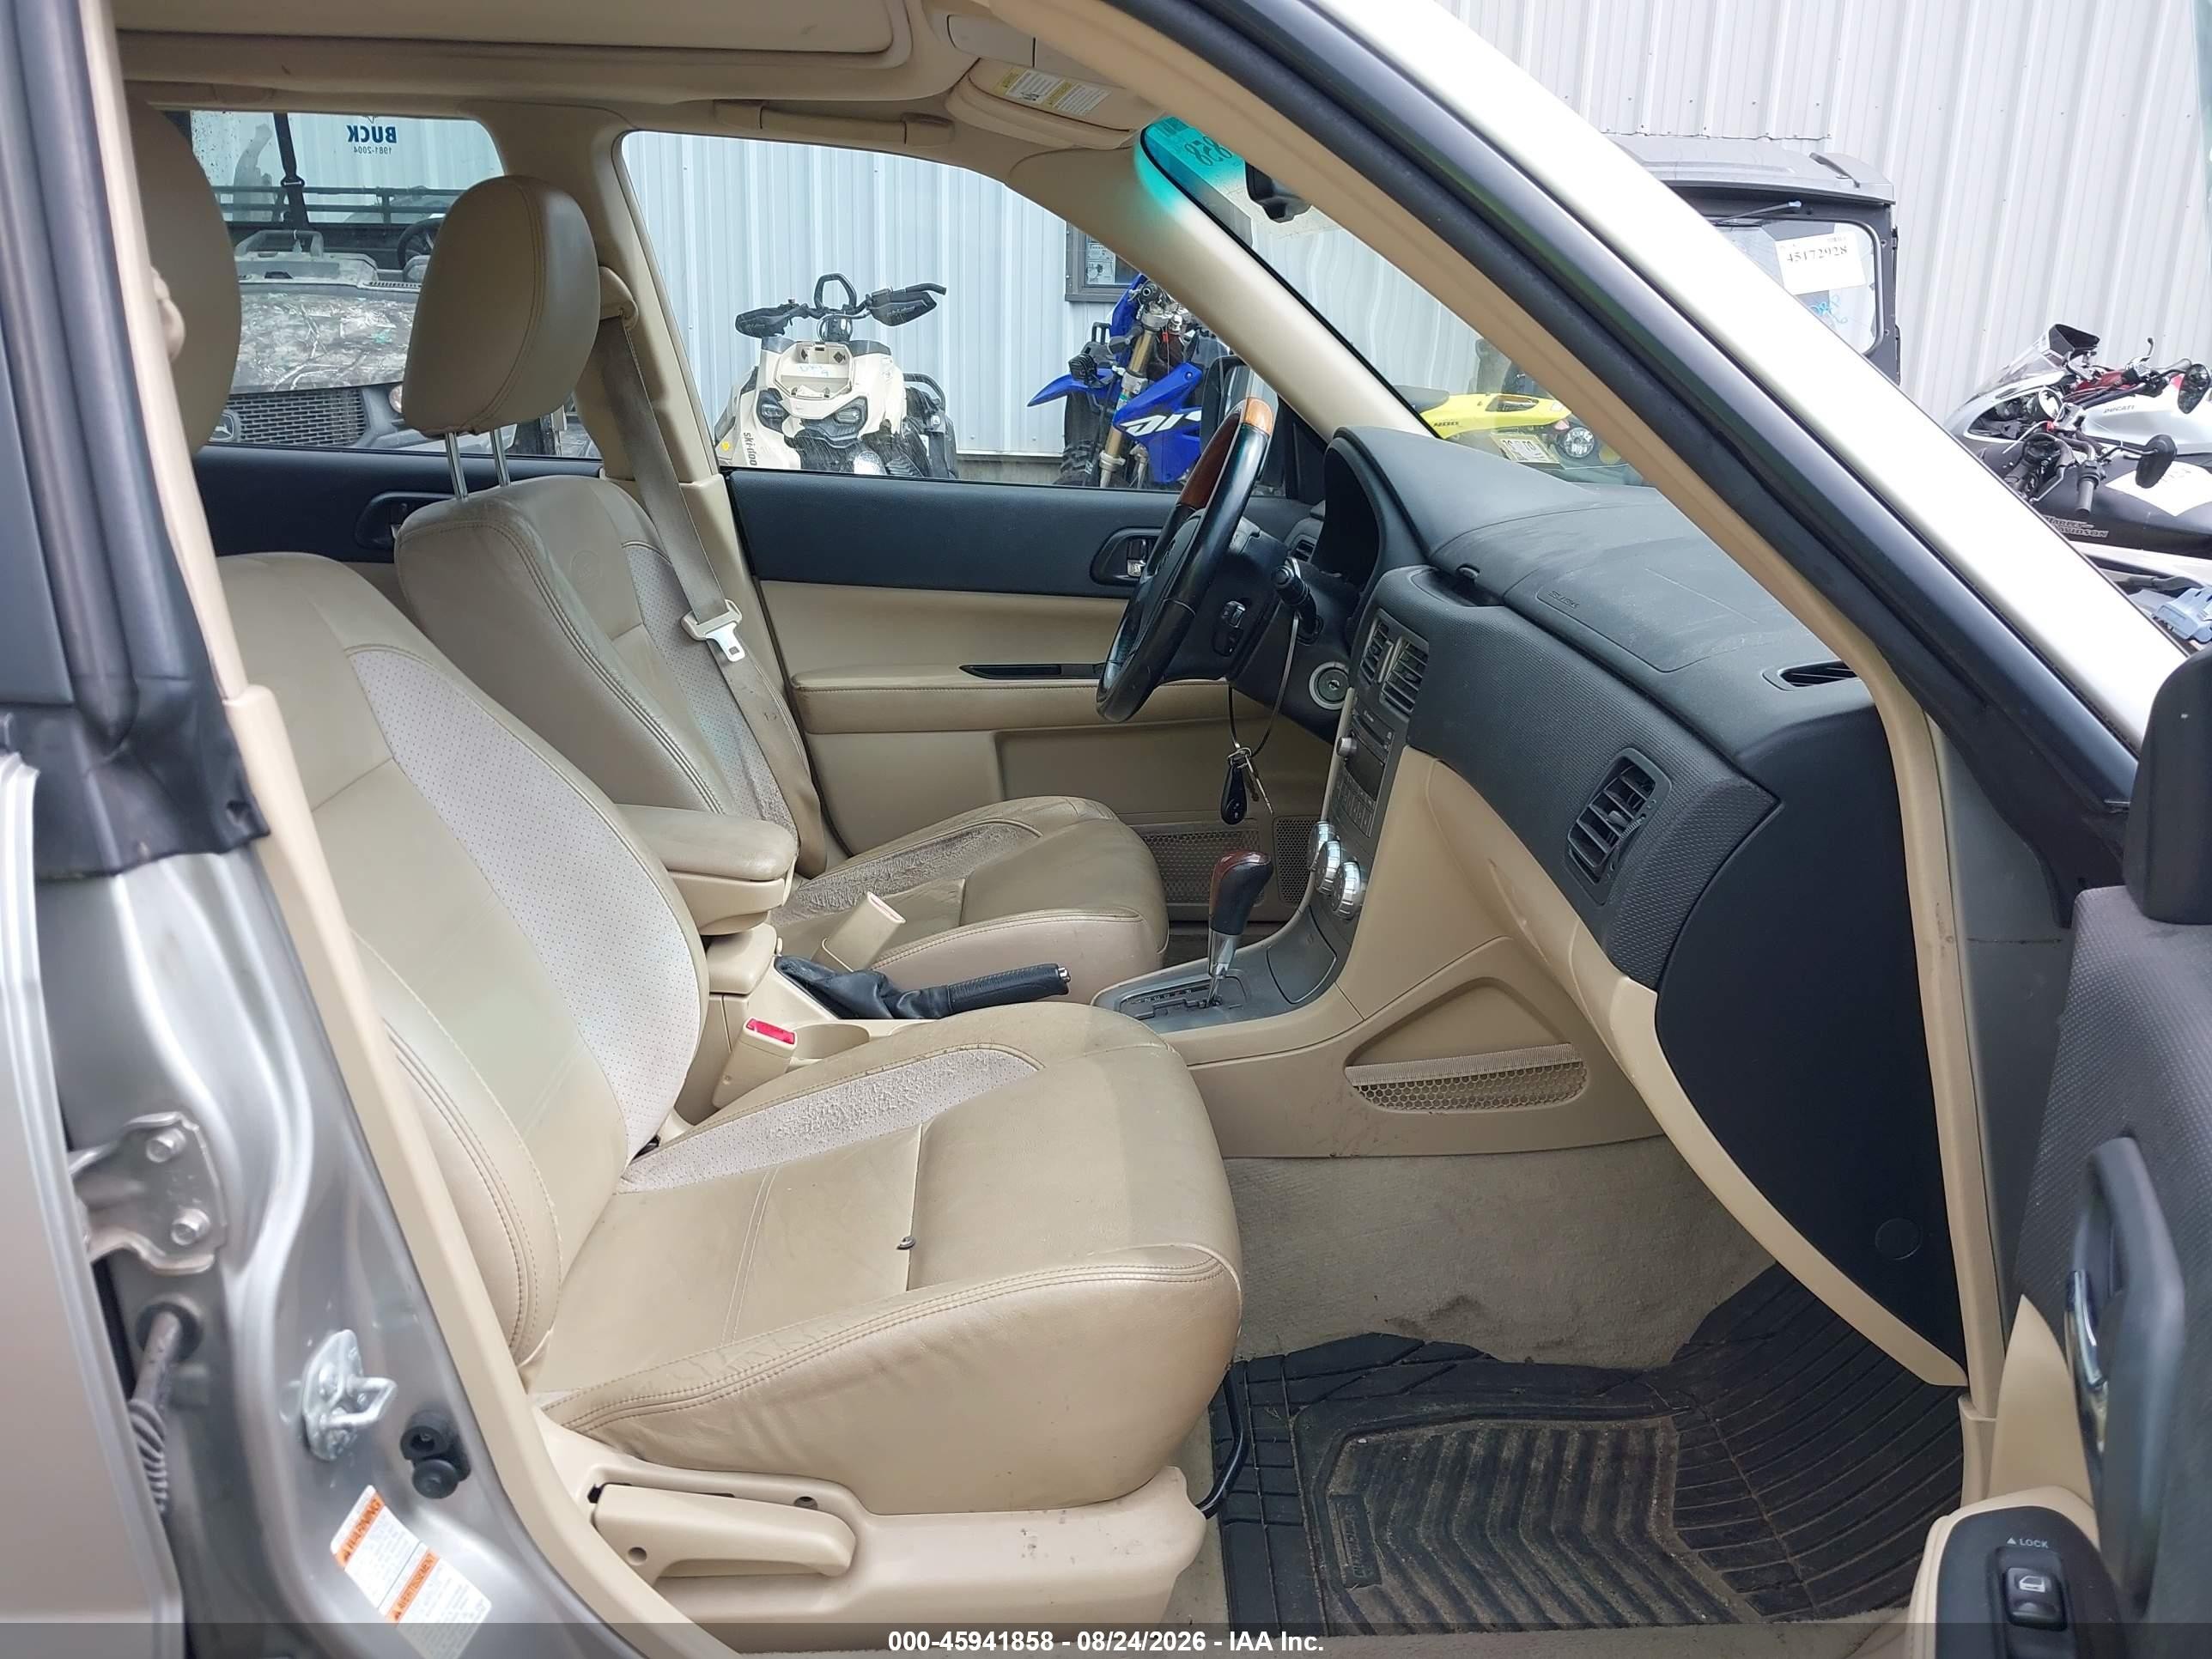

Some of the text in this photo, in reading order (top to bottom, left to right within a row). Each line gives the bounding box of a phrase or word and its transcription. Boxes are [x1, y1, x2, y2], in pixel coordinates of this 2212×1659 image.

[1787, 246, 1848, 262] 45172928
[2103, 404, 2136, 414] DUCATI
[345, 1497, 382, 1551] WARNING
[2019, 1538, 2049, 1549] LOCK
